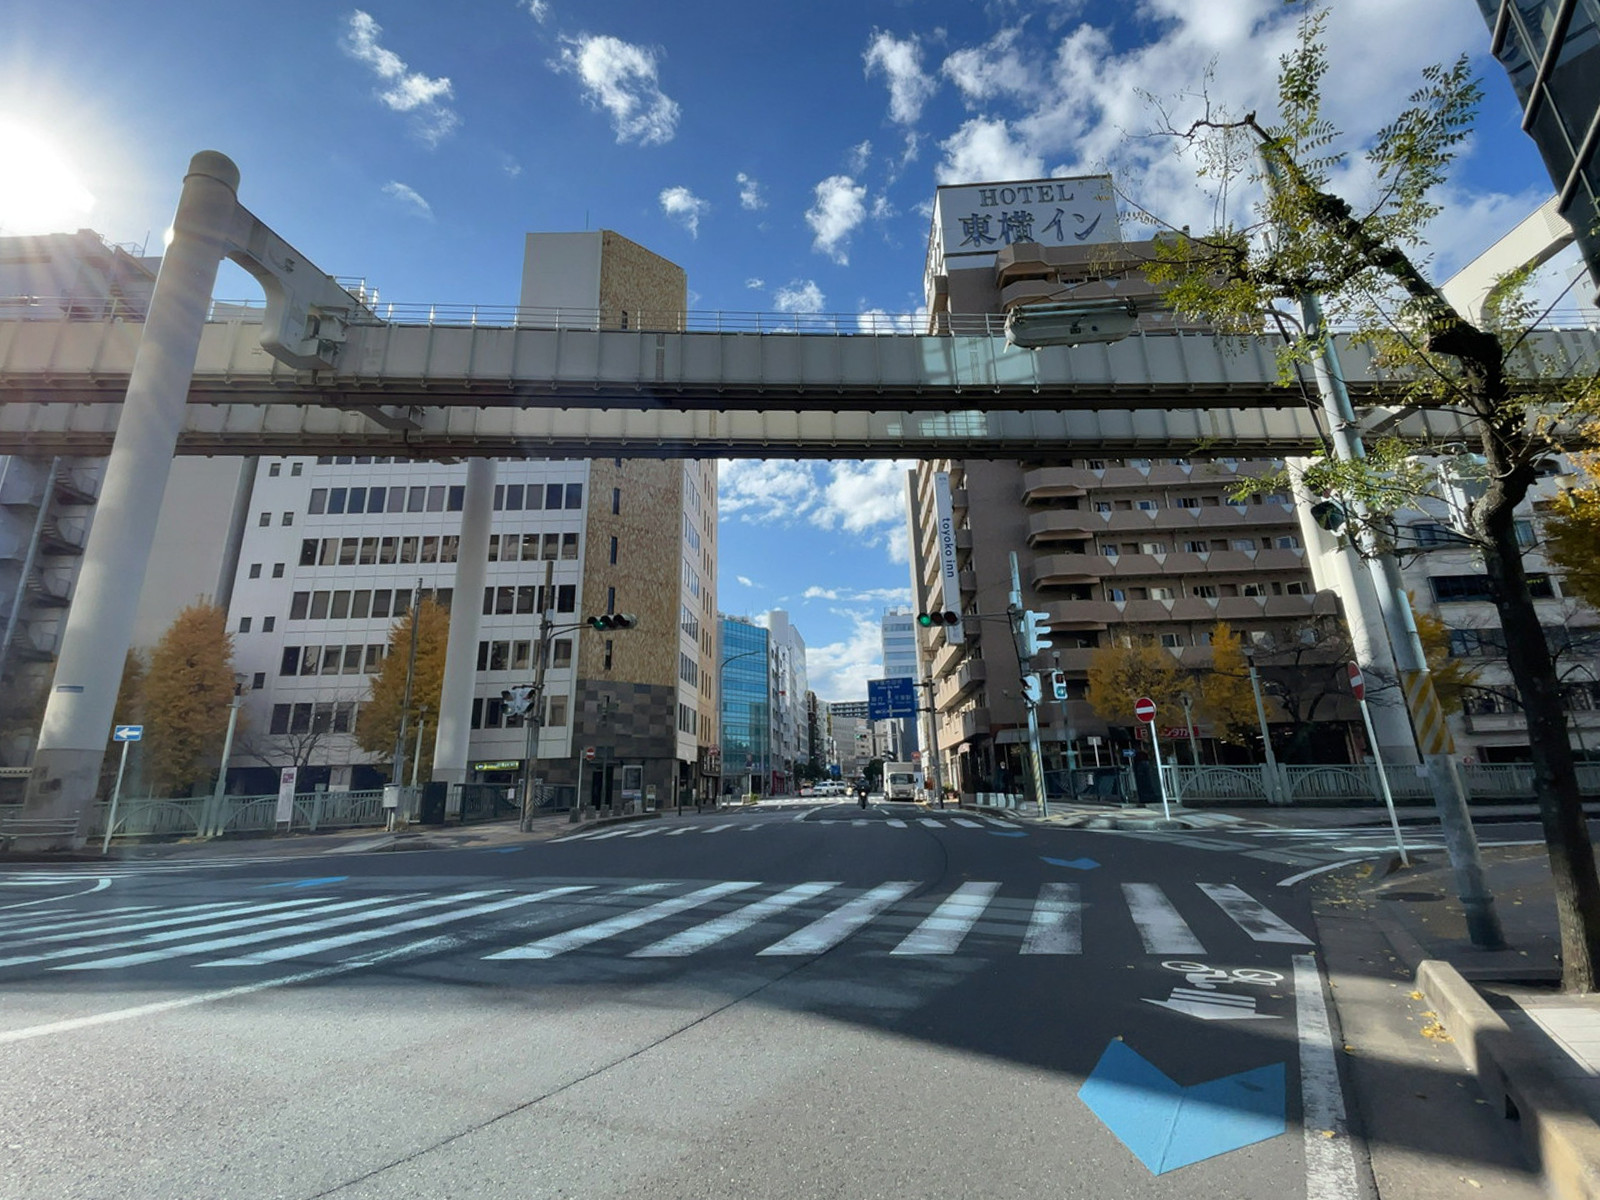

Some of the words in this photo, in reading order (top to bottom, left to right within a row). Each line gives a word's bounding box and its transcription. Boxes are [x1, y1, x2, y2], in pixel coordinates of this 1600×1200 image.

[980, 184, 1074, 207] HOTEL
[958, 207, 1102, 248] 東横イン
[941, 518, 954, 556] toyoko
[946, 560, 956, 578] inn
